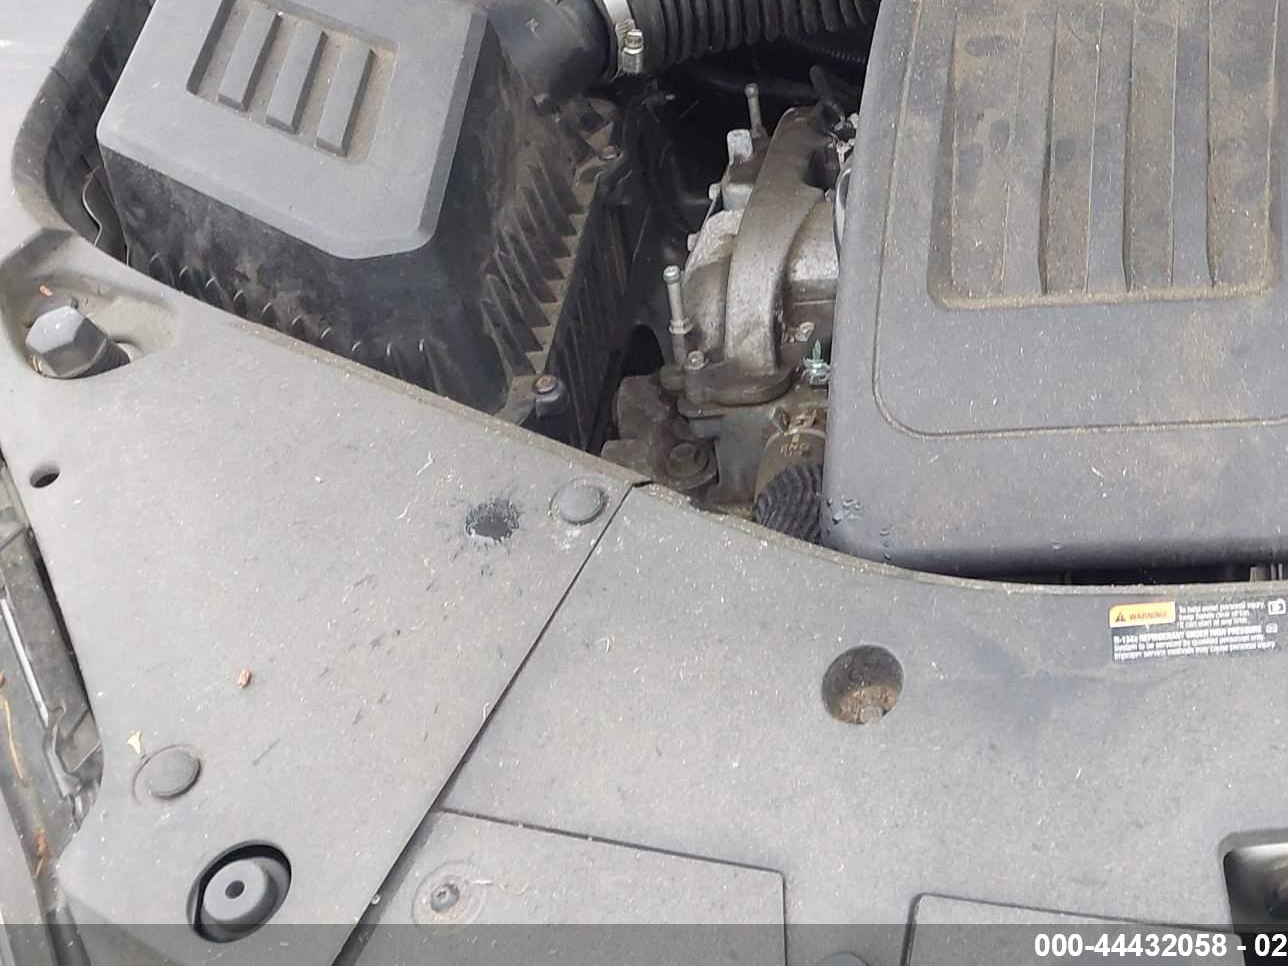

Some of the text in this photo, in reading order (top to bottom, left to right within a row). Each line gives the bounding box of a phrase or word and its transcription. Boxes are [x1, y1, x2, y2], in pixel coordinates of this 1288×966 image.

[1129, 610, 1168, 621] WARNING
[1113, 624, 1262, 644] R-134a REFRIGERANT UNDER HIGH PRESSURE
